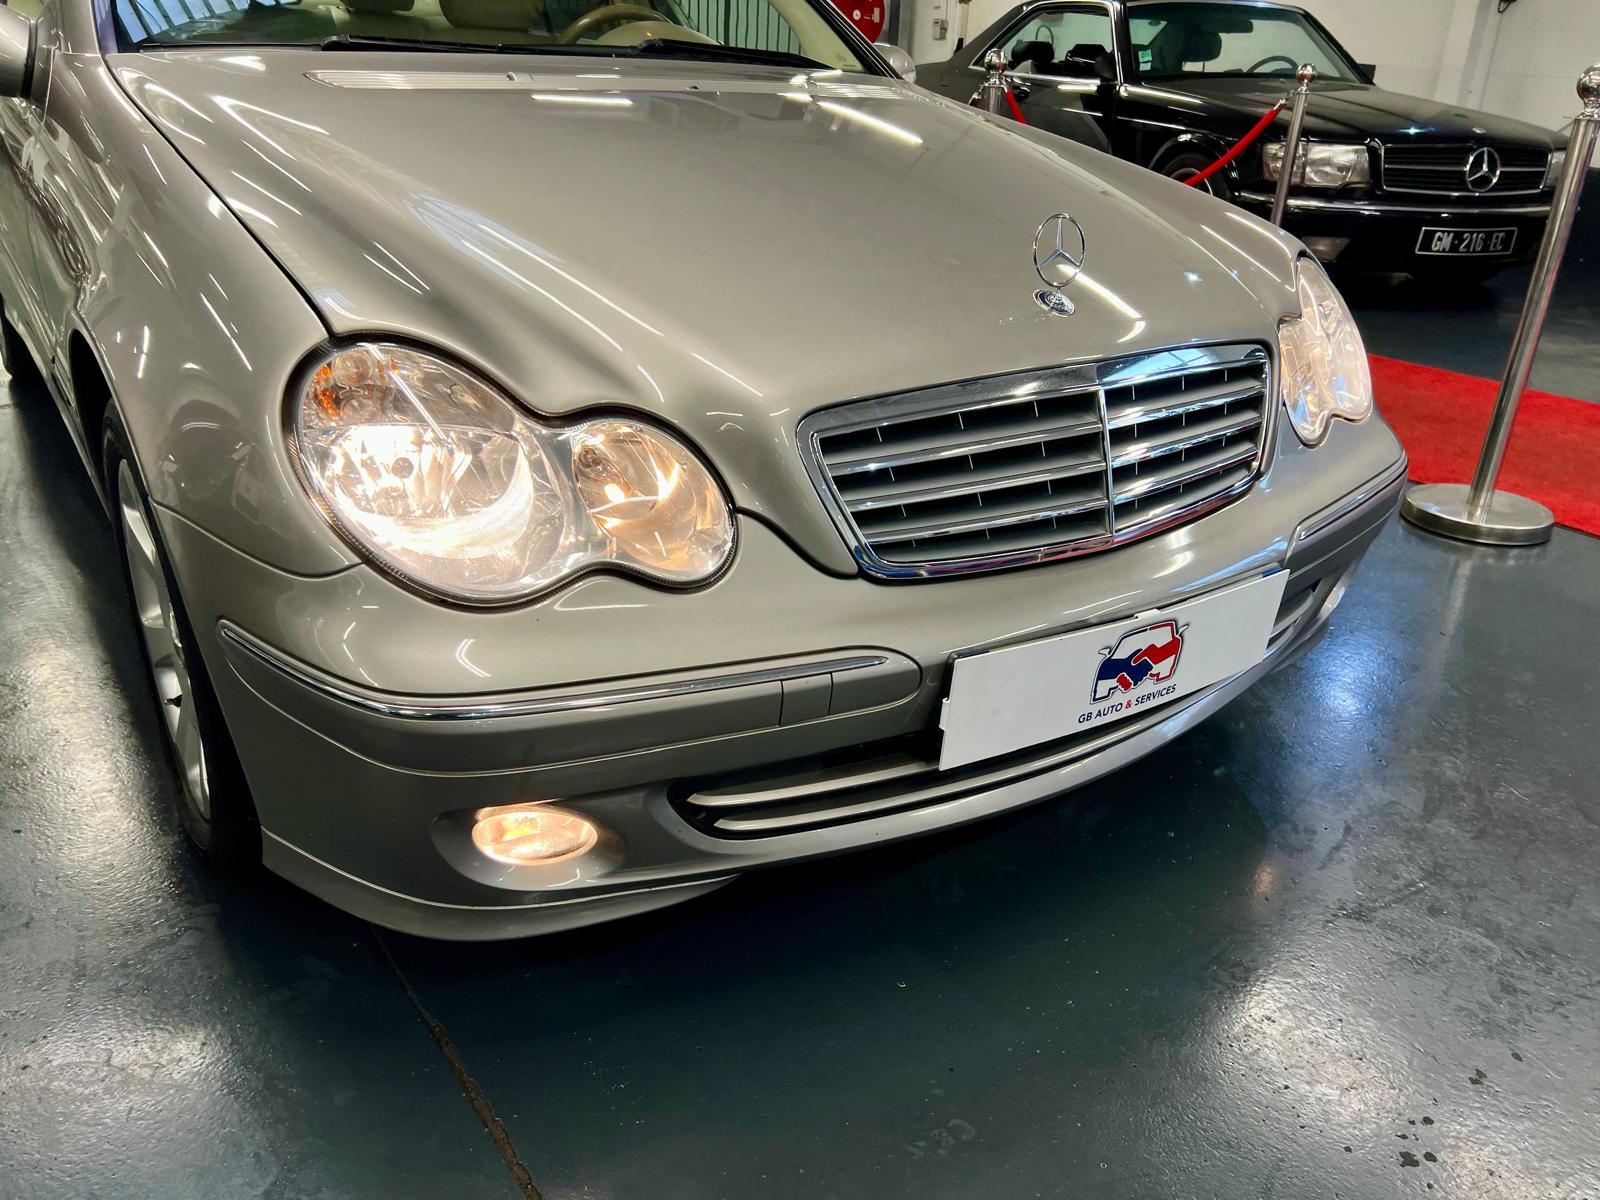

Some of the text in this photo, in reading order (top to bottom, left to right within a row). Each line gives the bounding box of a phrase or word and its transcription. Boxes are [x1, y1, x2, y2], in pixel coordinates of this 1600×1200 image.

[1078, 684, 1177, 724] GB AUTO & SERVICES
